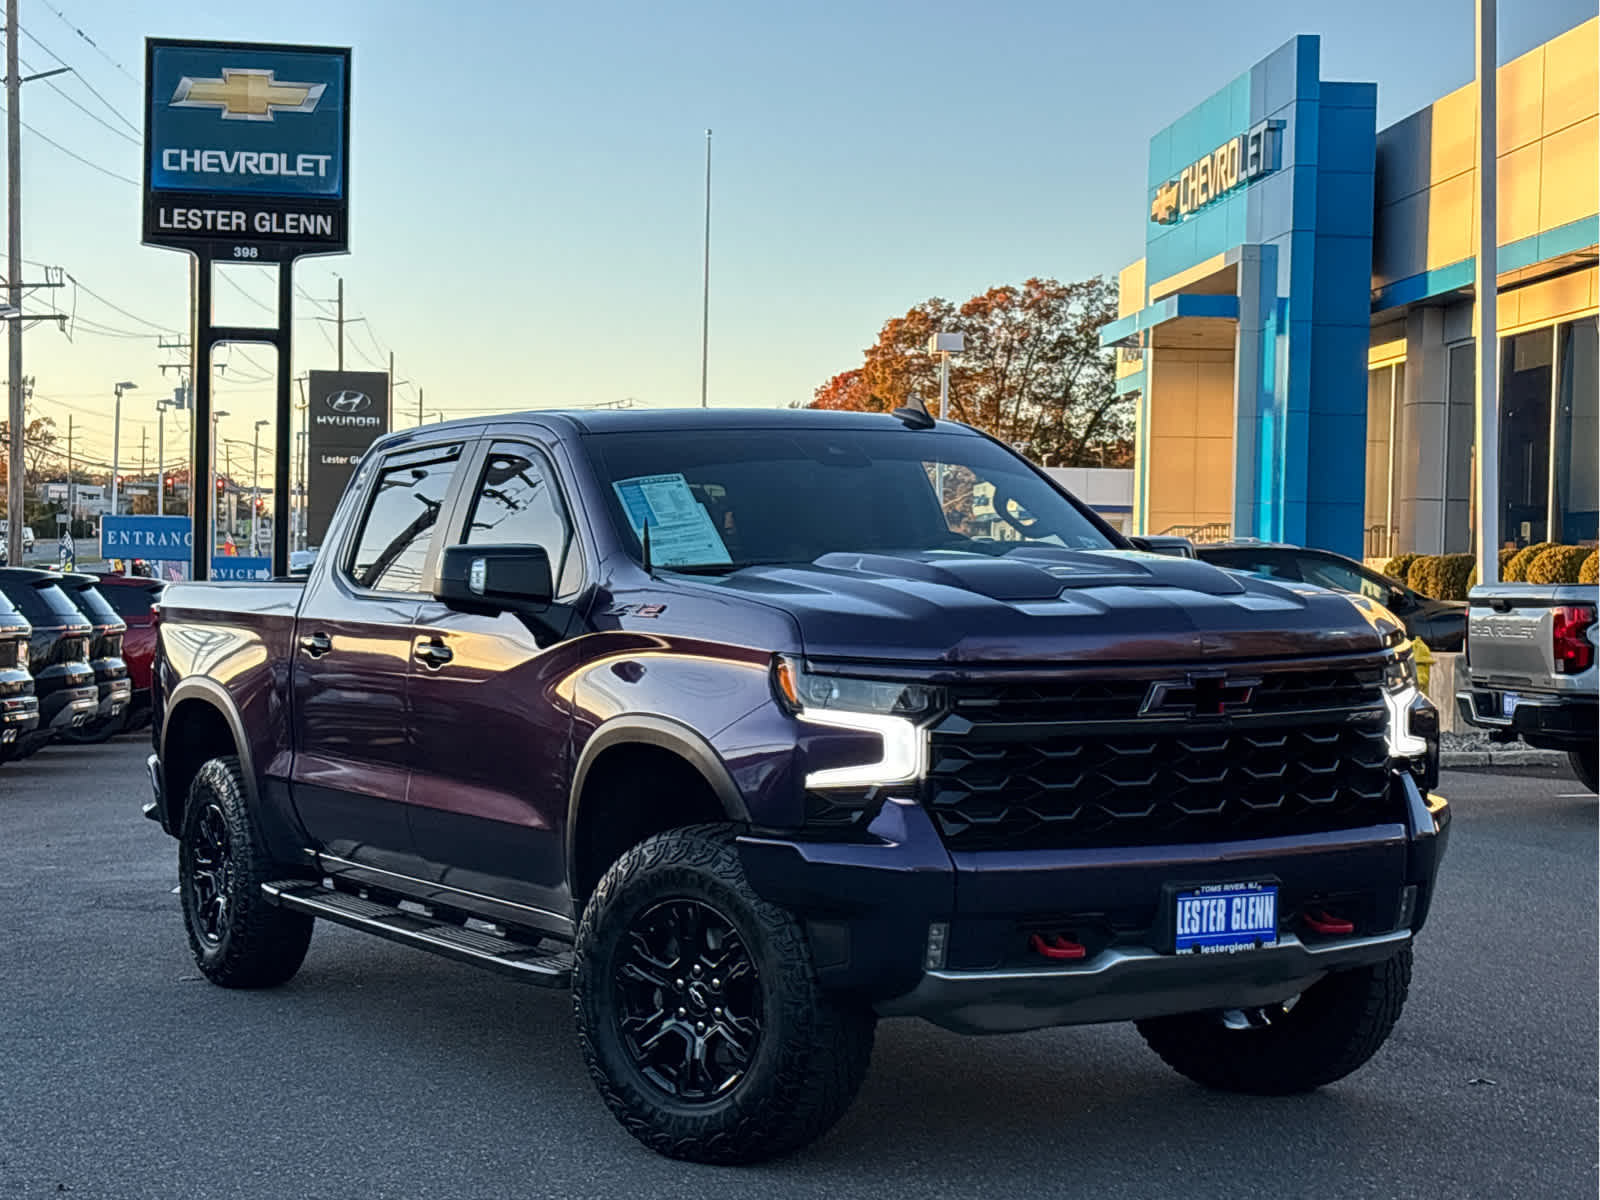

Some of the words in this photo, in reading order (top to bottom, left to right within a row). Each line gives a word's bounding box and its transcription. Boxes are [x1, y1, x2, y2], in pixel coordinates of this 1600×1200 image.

[162, 148, 332, 177] CHEVROLET
[1179, 119, 1287, 215] CHEVROLET
[159, 207, 246, 231] LESTER
[254, 211, 332, 236] GLENN
[233, 246, 258, 258] 398
[316, 415, 380, 427] HYUNDAI
[321, 455, 348, 464] Lester
[1200, 885, 1222, 894] TOMS
[1176, 898, 1227, 935] LESTER
[1231, 895, 1275, 931] GLENN
